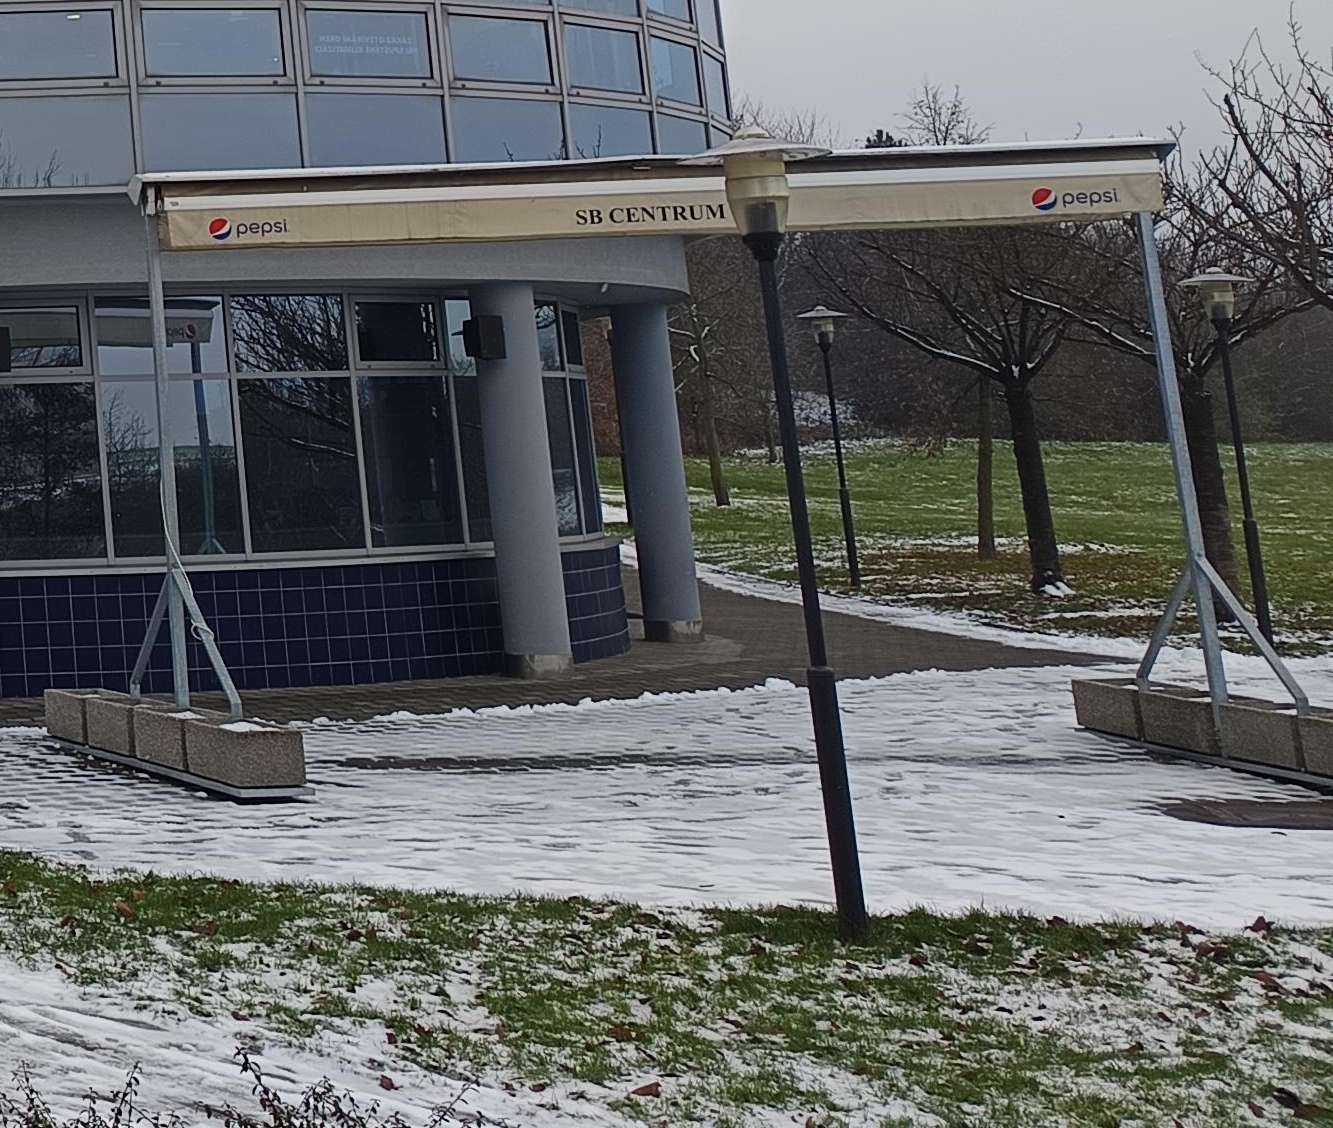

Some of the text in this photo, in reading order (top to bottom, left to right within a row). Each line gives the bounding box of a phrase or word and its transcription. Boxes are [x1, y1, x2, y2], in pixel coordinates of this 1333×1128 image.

[1062, 187, 1118, 208] pepsi
[575, 203, 725, 225] SB CENTRUM
[237, 218, 288, 238] pepsi
